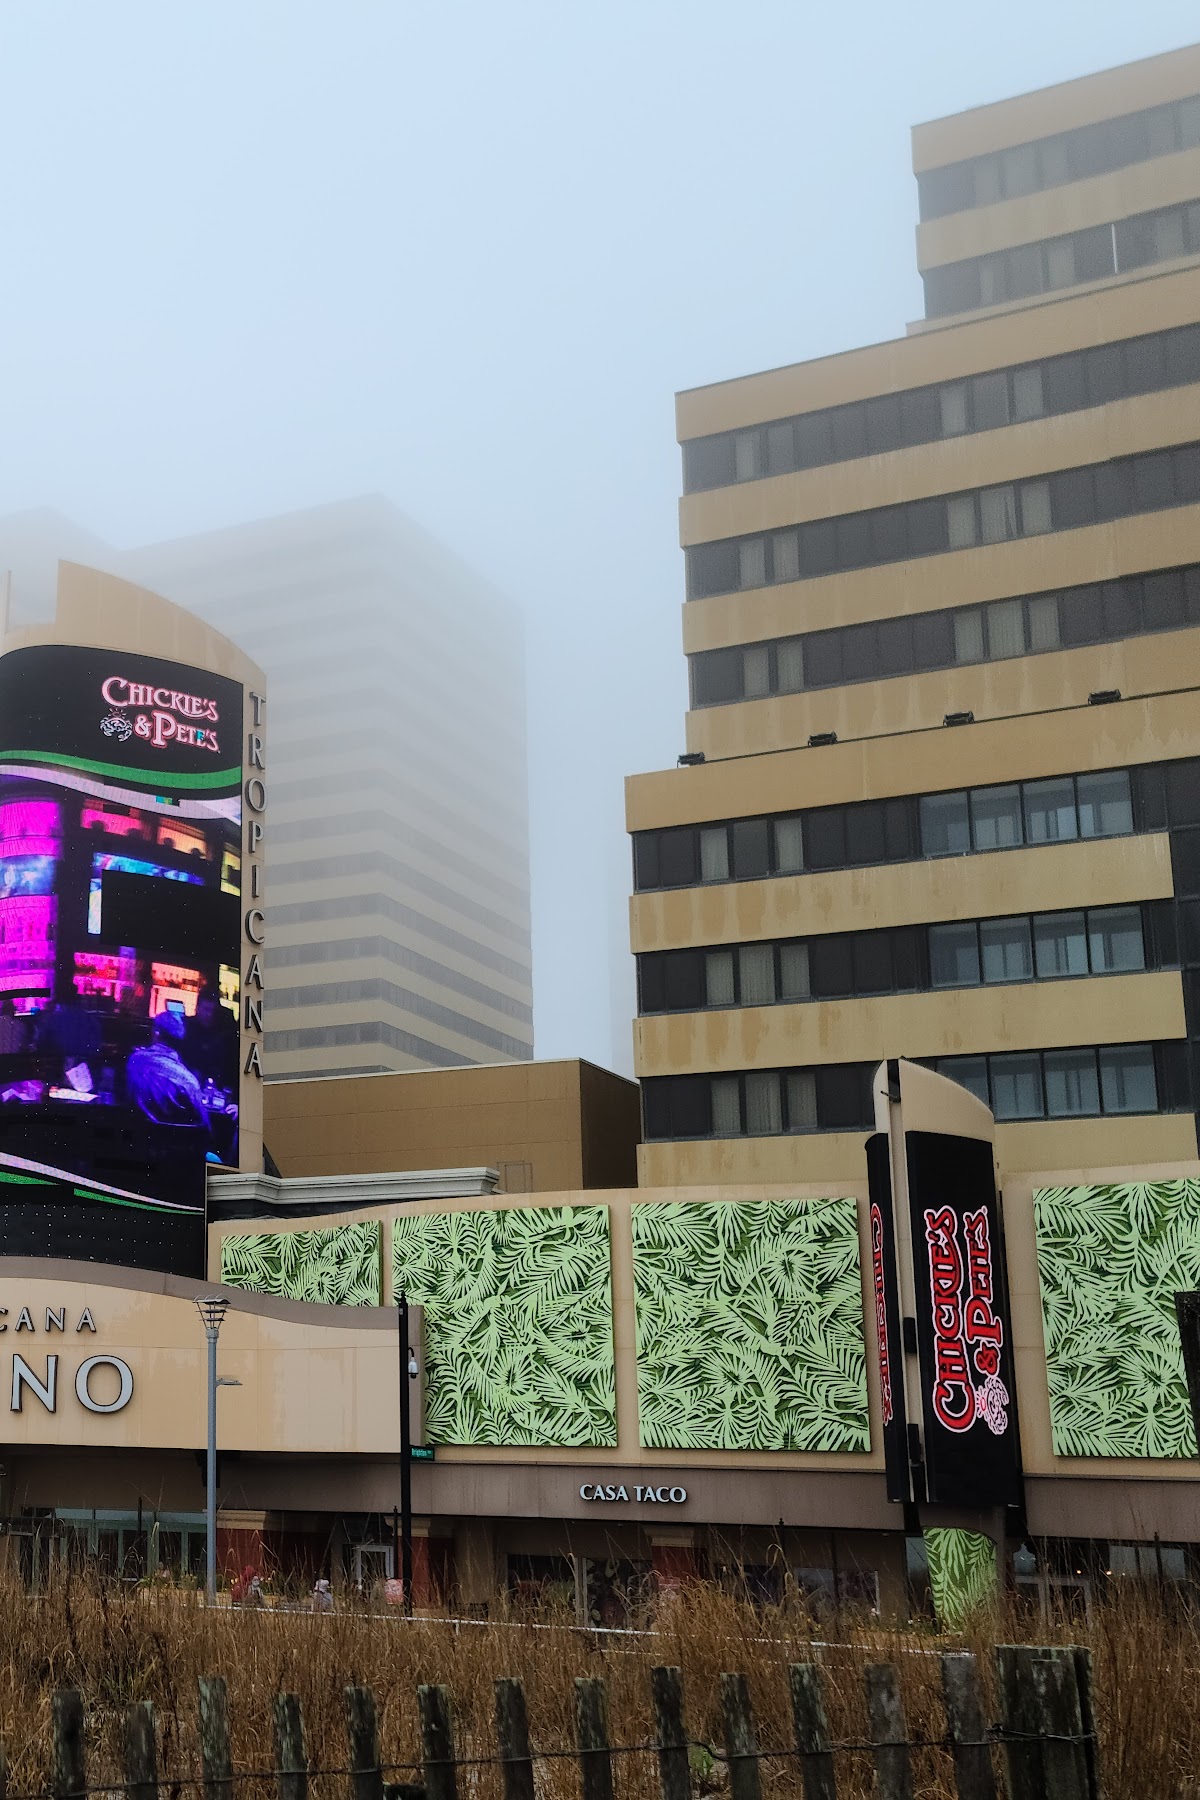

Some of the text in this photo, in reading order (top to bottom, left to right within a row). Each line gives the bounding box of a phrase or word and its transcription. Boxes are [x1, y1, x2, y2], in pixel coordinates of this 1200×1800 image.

[101, 676, 219, 722] CHICKIE'S
[134, 709, 220, 753] & PETE'S
[245, 691, 267, 1077] TROPICANA
[924, 1205, 976, 1433] CHICKIE'S
[963, 1205, 1003, 1377] & PETE'S
[580, 1484, 687, 1503] CASA TACO
